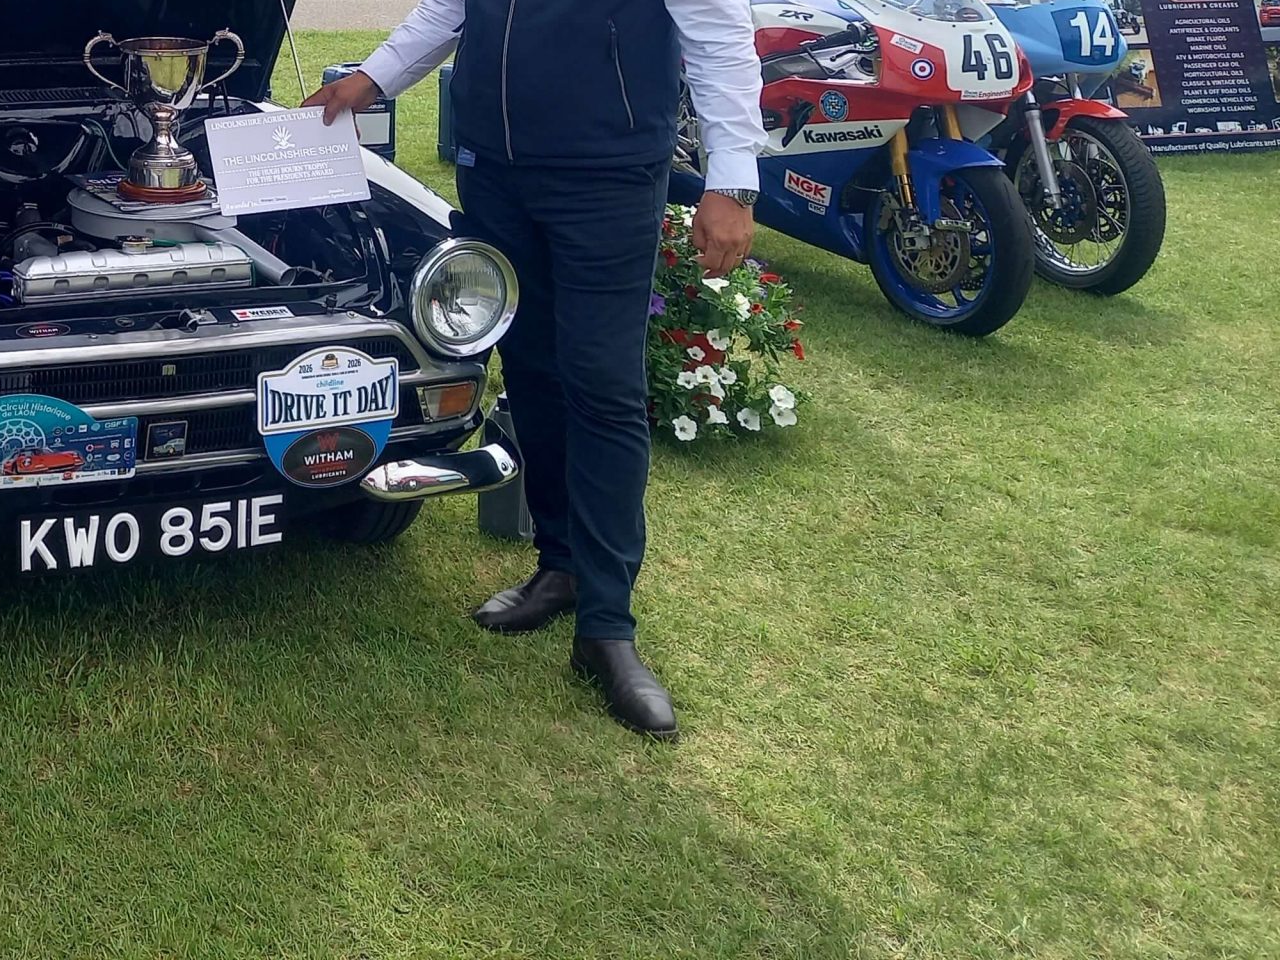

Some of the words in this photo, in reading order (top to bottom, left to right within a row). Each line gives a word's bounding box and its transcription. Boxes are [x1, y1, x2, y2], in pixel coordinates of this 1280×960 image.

[778, 9, 814, 21] ZXR
[1069, 10, 1115, 57] 14
[961, 34, 1013, 81] 46
[978, 89, 1012, 98] Engineering
[211, 119, 262, 130] LINCOLNSHIRE
[262, 111, 314, 124] AGRICULTURAL
[803, 125, 884, 144] Kawasaki
[1151, 144, 1198, 152] Manufacturers
[1206, 142, 1229, 151] Quality
[1230, 140, 1263, 149] Lubricants
[1264, 139, 1276, 147] and
[223, 156, 244, 167] THE
[245, 147, 318, 164] LINCOLNSHIRE
[318, 143, 350, 156] SHOW
[303, 162, 329, 171] TROPHY
[273, 171, 311, 182] PRESIDENTS
[311, 168, 334, 177] AWARD
[788, 173, 827, 199] NGK
[248, 307, 289, 317] WEBER
[28, 327, 60, 335] WITHAM
[298, 363, 313, 374] 2026
[347, 358, 362, 369] 2026
[316, 379, 345, 389] childline
[270, 389, 327, 425] DRIVE
[332, 390, 352, 417] IT
[357, 374, 394, 414] DAY
[0, 402, 29, 412] Circuit
[31, 402, 72, 421] Historique
[2, 410, 13, 418] de
[14, 409, 36, 417] LAON
[304, 449, 354, 466] WITHAM
[311, 470, 346, 480] LUBRICANTS
[20, 512, 140, 572] KWO
[160, 494, 284, 557] 851E
